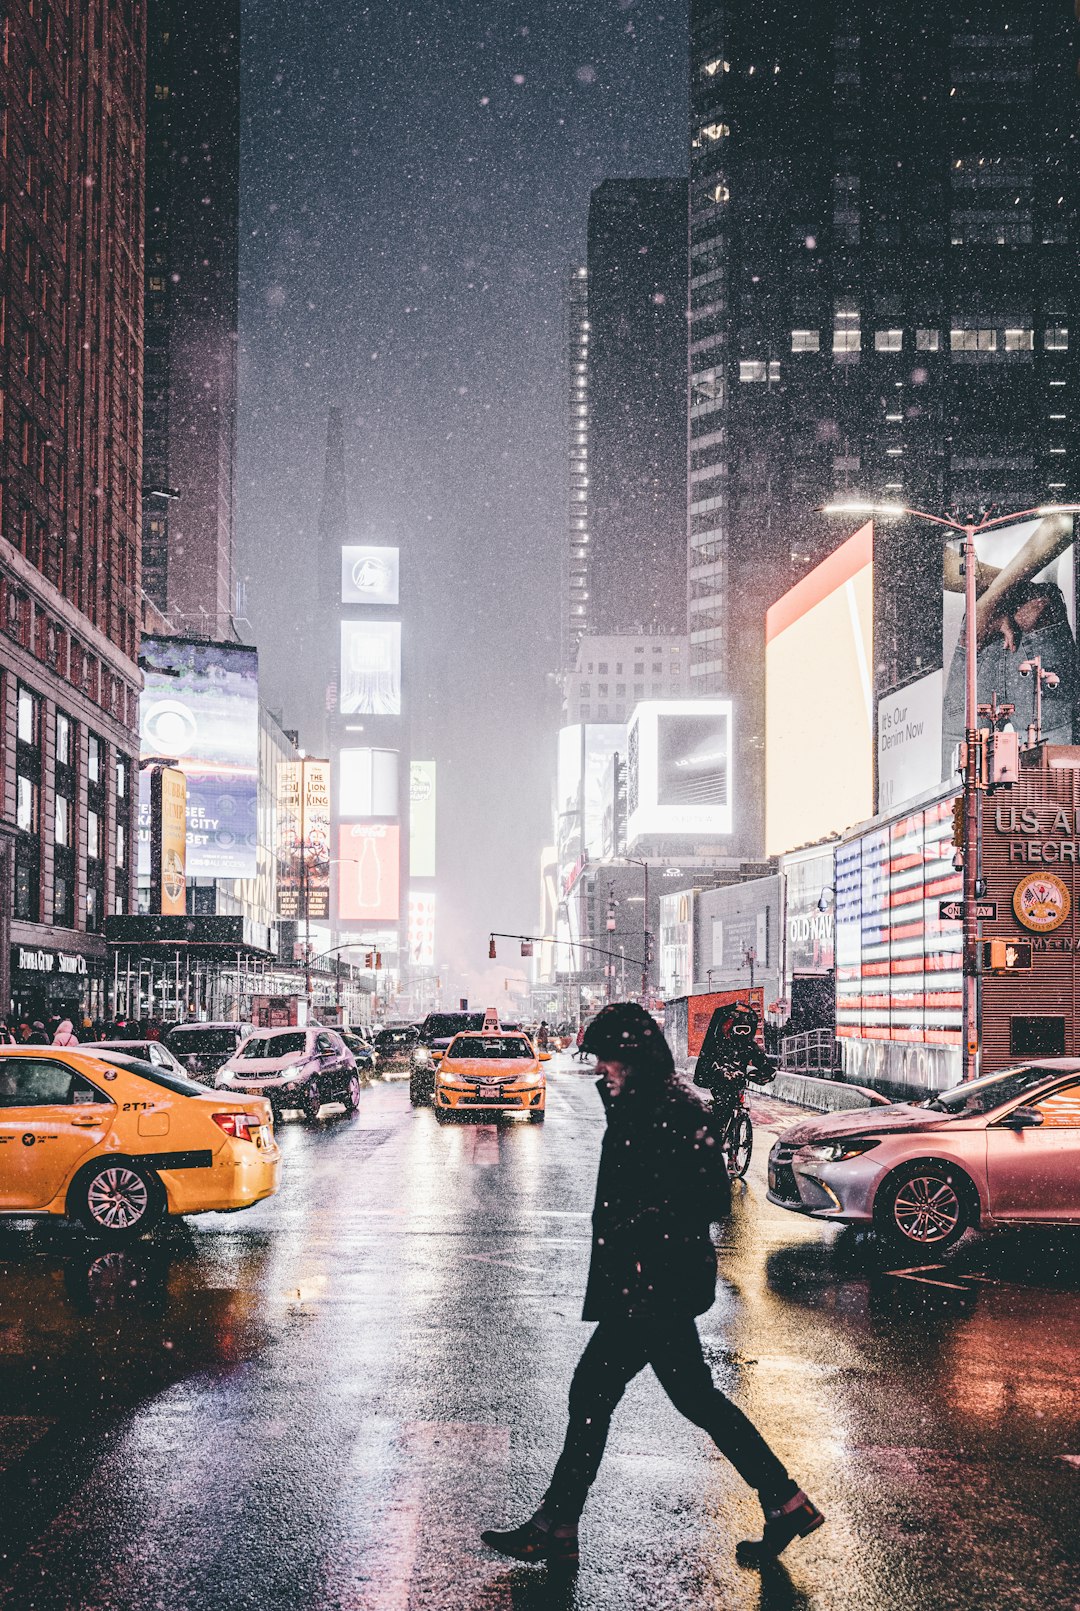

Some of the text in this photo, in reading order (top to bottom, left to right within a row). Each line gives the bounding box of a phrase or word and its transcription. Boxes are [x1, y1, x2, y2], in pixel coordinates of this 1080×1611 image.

[881, 707, 908, 731] It's Our
[881, 721, 924, 752] Denim Now
[307, 781, 326, 793] LION
[306, 793, 329, 806] KING
[190, 819, 219, 830] CITY
[996, 806, 1045, 833] U.S.
[1010, 841, 1080, 863] RECR
[947, 907, 965, 915] ONE
[790, 918, 811, 942] OLD
